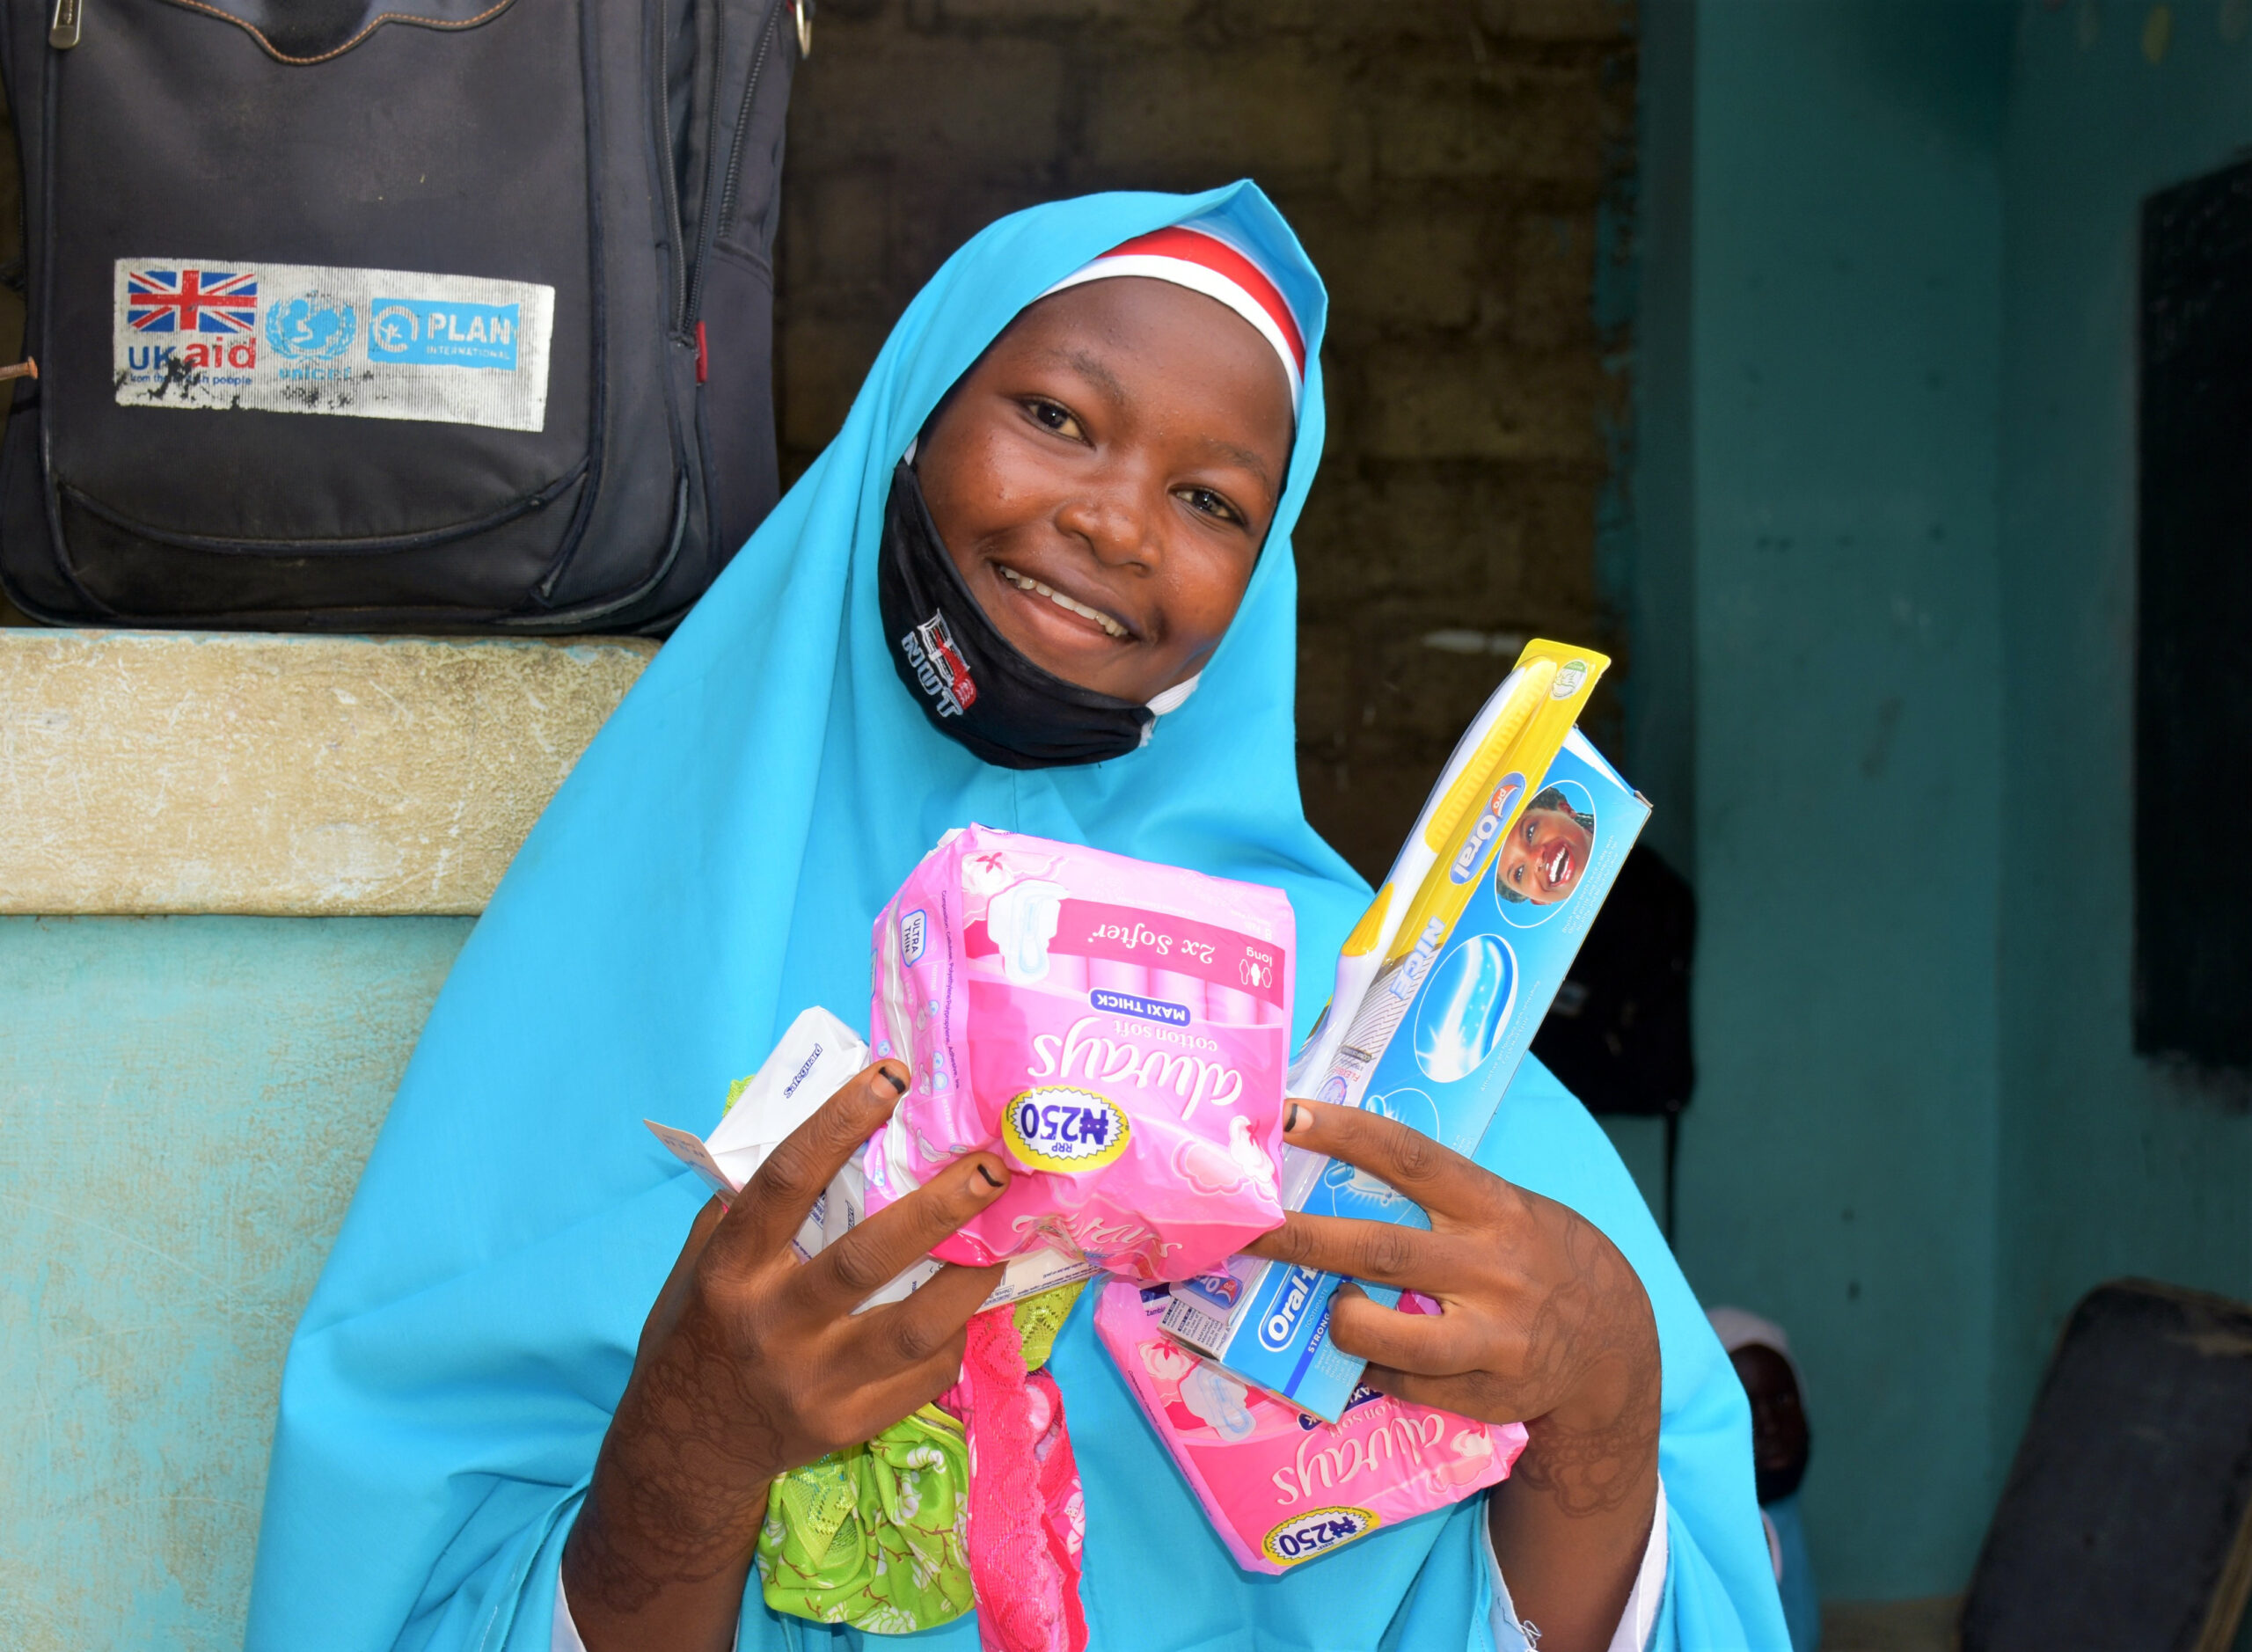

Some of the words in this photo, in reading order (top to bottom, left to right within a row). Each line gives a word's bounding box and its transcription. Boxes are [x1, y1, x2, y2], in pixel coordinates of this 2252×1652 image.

[428, 313, 510, 345] PLAN
[128, 345, 177, 370] UK
[184, 337, 257, 369] aid
[427, 346, 511, 360] INTERNATIONAL
[1452, 815, 1501, 879] Oral
[903, 926, 912, 954] THIN
[910, 917, 921, 954] ULTRA
[1181, 941, 1216, 964] 2x
[1246, 946, 1273, 965] long
[1096, 993, 1142, 1012] THICK
[1143, 1004, 1186, 1021] MAXI
[1113, 1019, 1152, 1041] soft
[1158, 1029, 1218, 1052] cotton
[783, 1042, 823, 1099] Safeguard
[1027, 1017, 1244, 1122] always
[1051, 1141, 1073, 1153] RRP
[1304, 1286, 1329, 1330] TOOTHPASTE
[1272, 1413, 1445, 1506] always
[1278, 1516, 1358, 1556] ₦250
